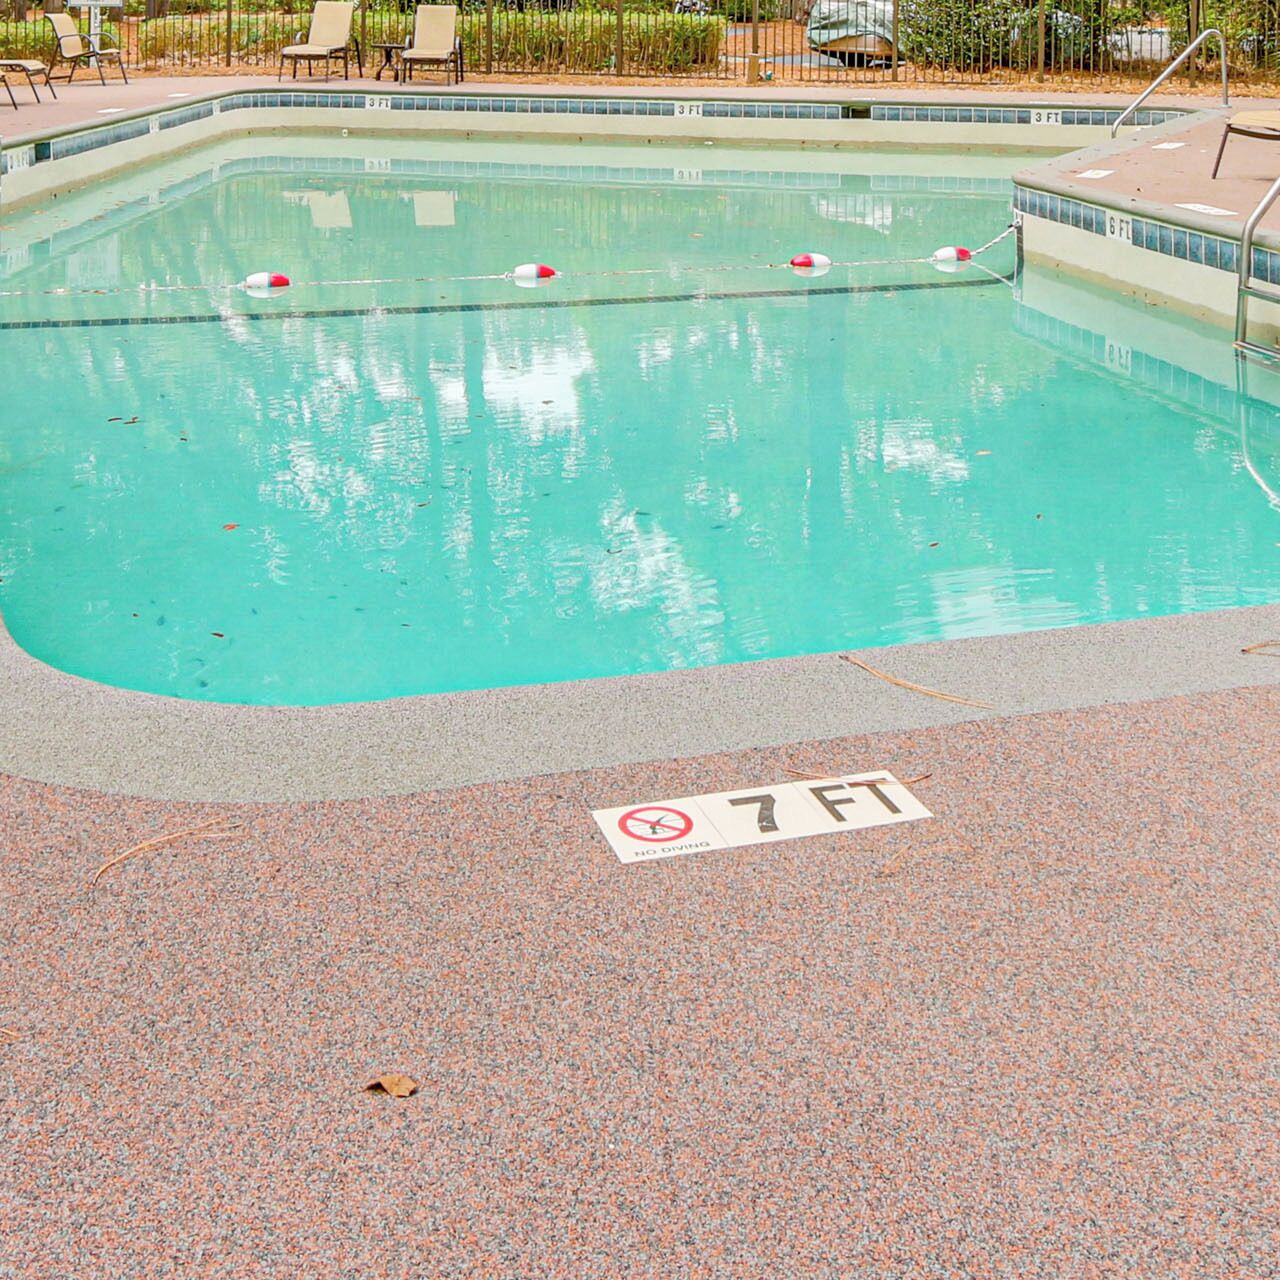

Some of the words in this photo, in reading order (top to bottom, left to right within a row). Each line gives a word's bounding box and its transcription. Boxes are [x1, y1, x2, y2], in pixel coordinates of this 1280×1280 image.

[369, 97, 375, 108] 3
[678, 104, 685, 115] 3
[1035, 112, 1041, 122] 3
[1110, 216, 1116, 235] 6
[728, 793, 780, 834] 7
[808, 777, 903, 823] FT
[634, 849, 657, 857] NO
[661, 841, 711, 853] DIVING
